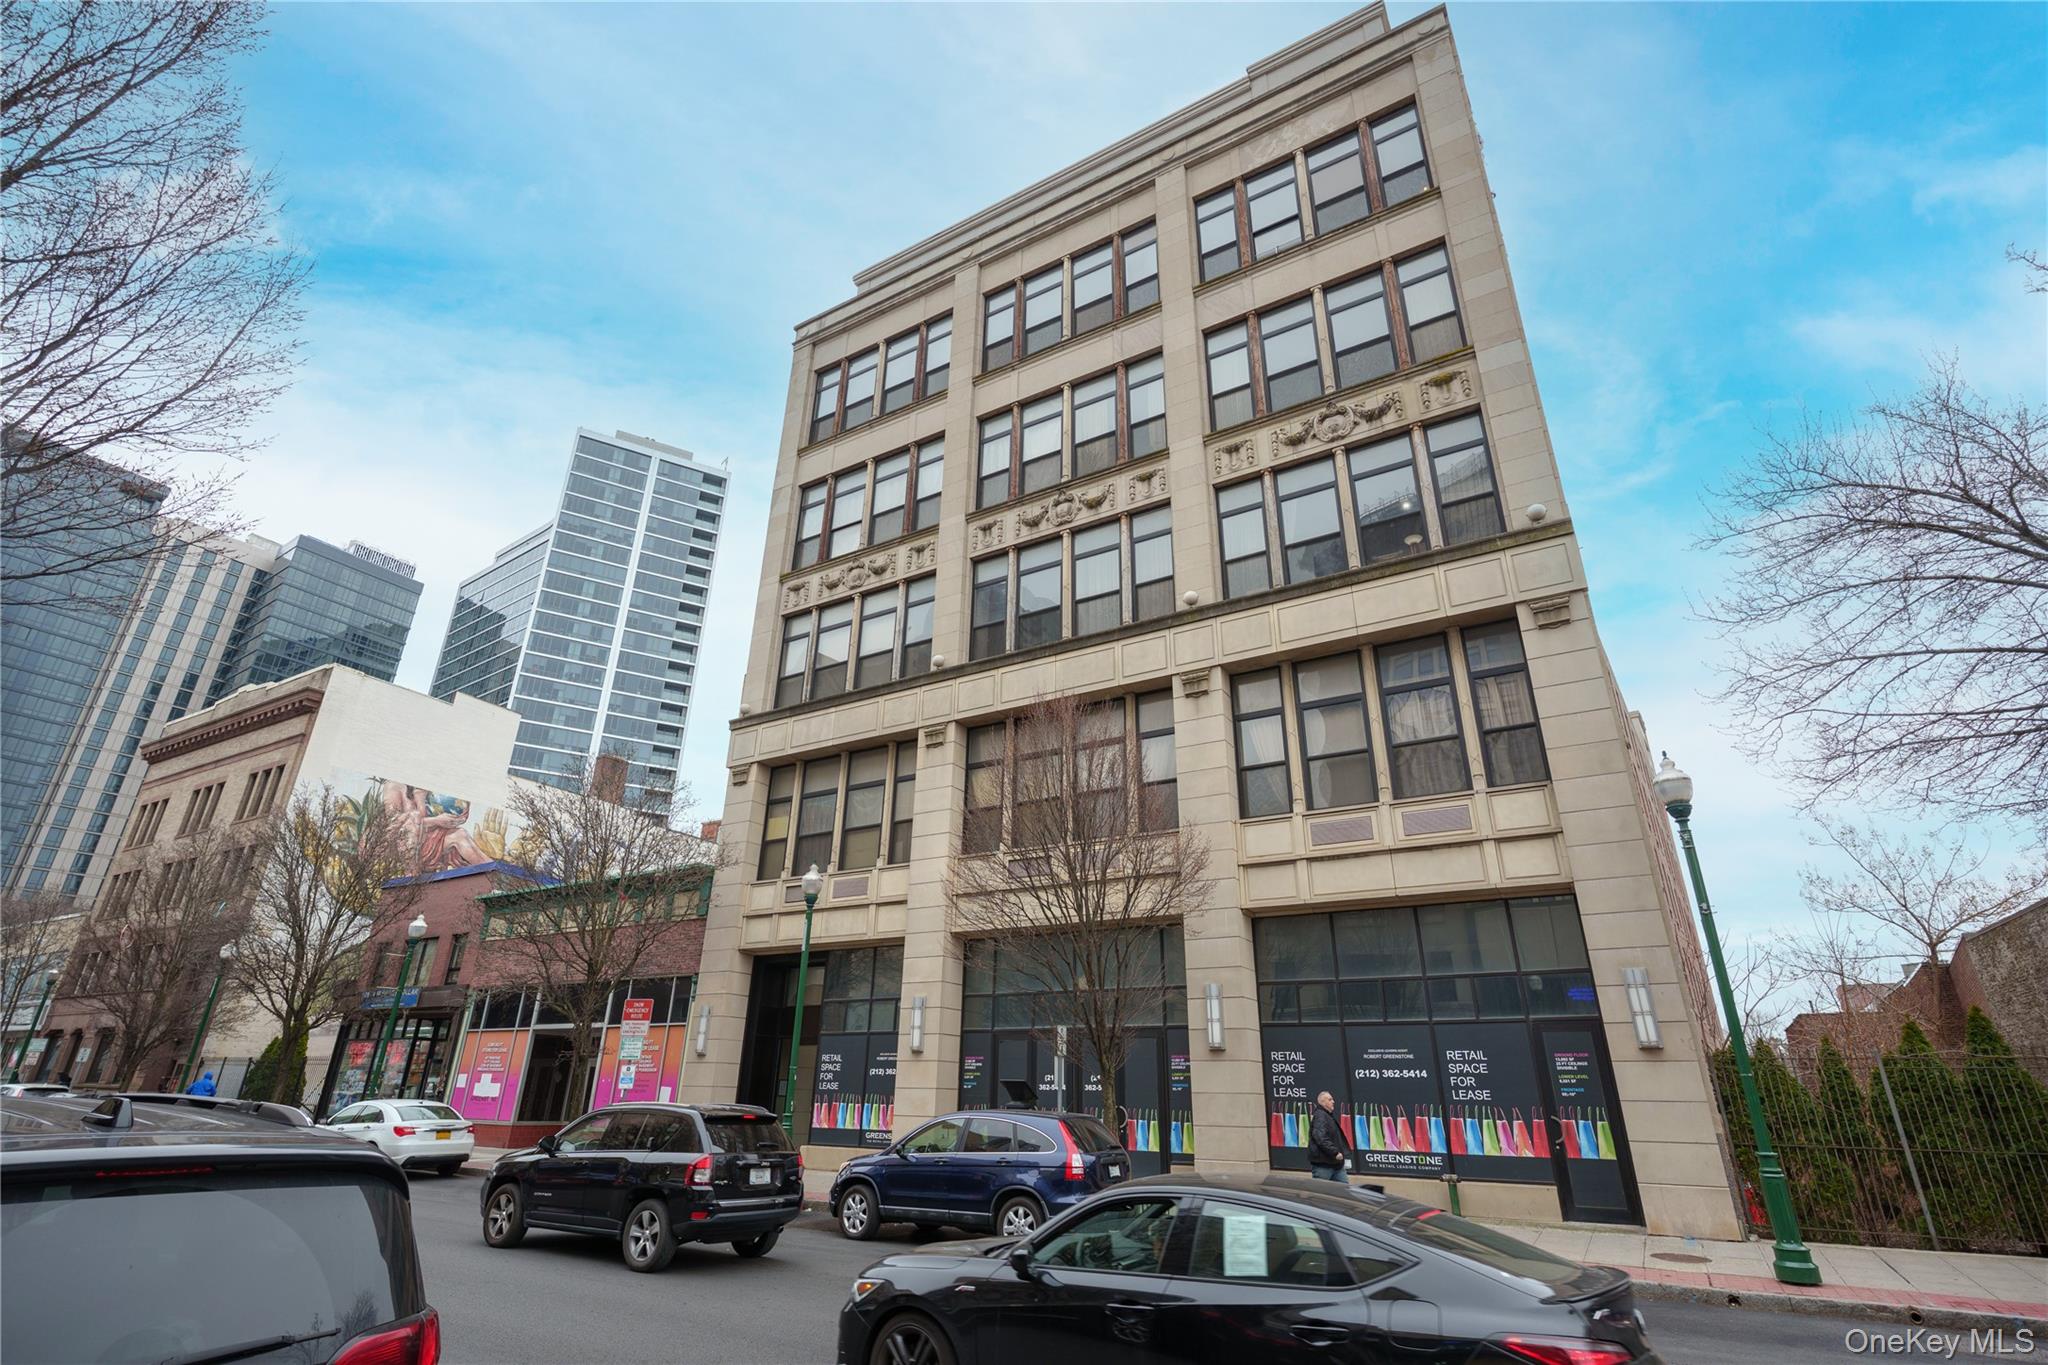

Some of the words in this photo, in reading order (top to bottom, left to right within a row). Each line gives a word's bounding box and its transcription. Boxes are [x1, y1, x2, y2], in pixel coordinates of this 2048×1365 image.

[821, 1054, 843, 1062] RETAIL
[1271, 1051, 1306, 1061] RETAIL
[1446, 1050, 1488, 1061] RETAIL
[820, 1063, 842, 1072] SPACE
[869, 1068, 884, 1077] (212)
[1271, 1063, 1306, 1073] SPACE
[1448, 1063, 1489, 1074] SPACE
[819, 1072, 833, 1080] FOR
[1355, 1069, 1380, 1079] (212)
[1382, 1069, 1428, 1079] 362-5414
[1272, 1075, 1295, 1085] FOR
[1450, 1077, 1476, 1087] FOR
[818, 1082, 839, 1090] LEASE
[1273, 1088, 1307, 1098] LEASE
[1452, 1089, 1492, 1101] LEASE
[1365, 1153, 1443, 1166] GREENSTONE
